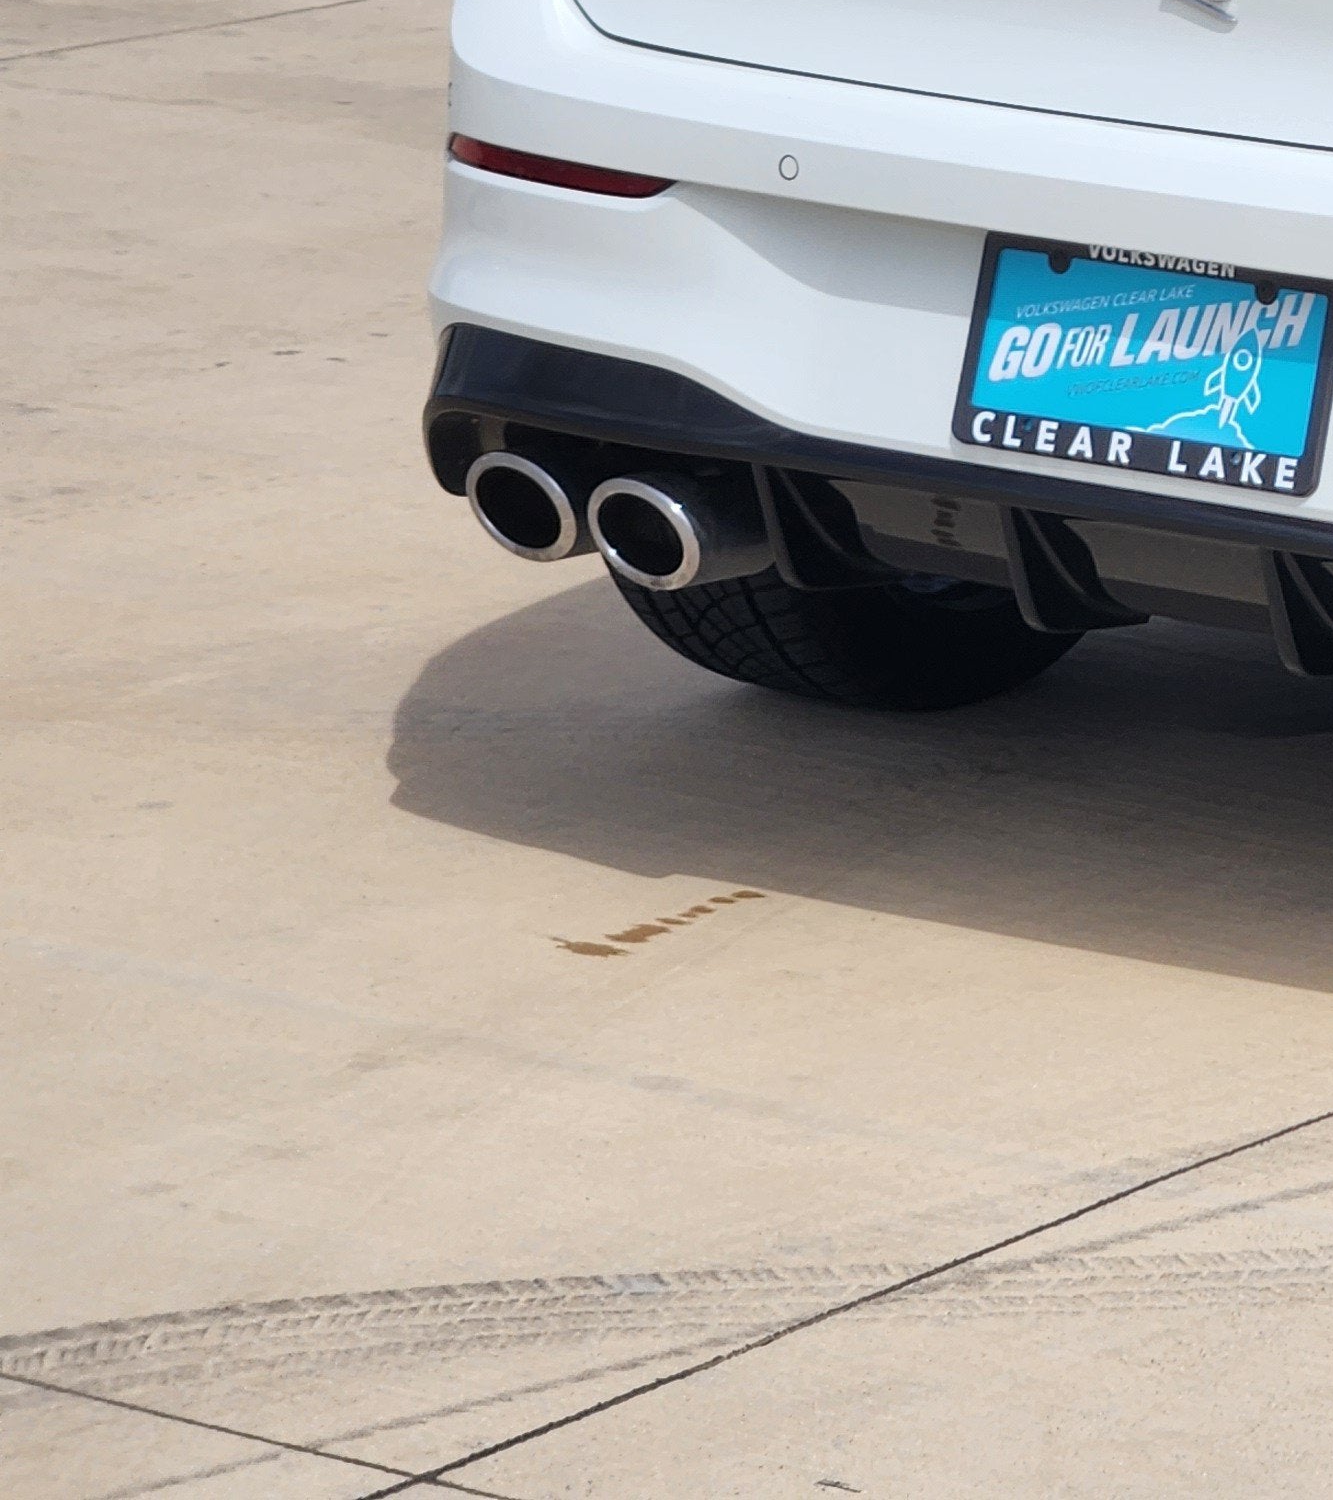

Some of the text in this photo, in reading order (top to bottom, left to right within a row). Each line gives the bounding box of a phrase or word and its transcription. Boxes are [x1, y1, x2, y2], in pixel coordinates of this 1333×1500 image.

[1088, 244, 1236, 278] VOLKSWAGEN
[1017, 284, 1196, 319] VOLKSWAGEN CLEAR LAKE
[988, 291, 1315, 382] GO FOR LAUNCH
[970, 410, 1299, 490] CLEAR LAKE
